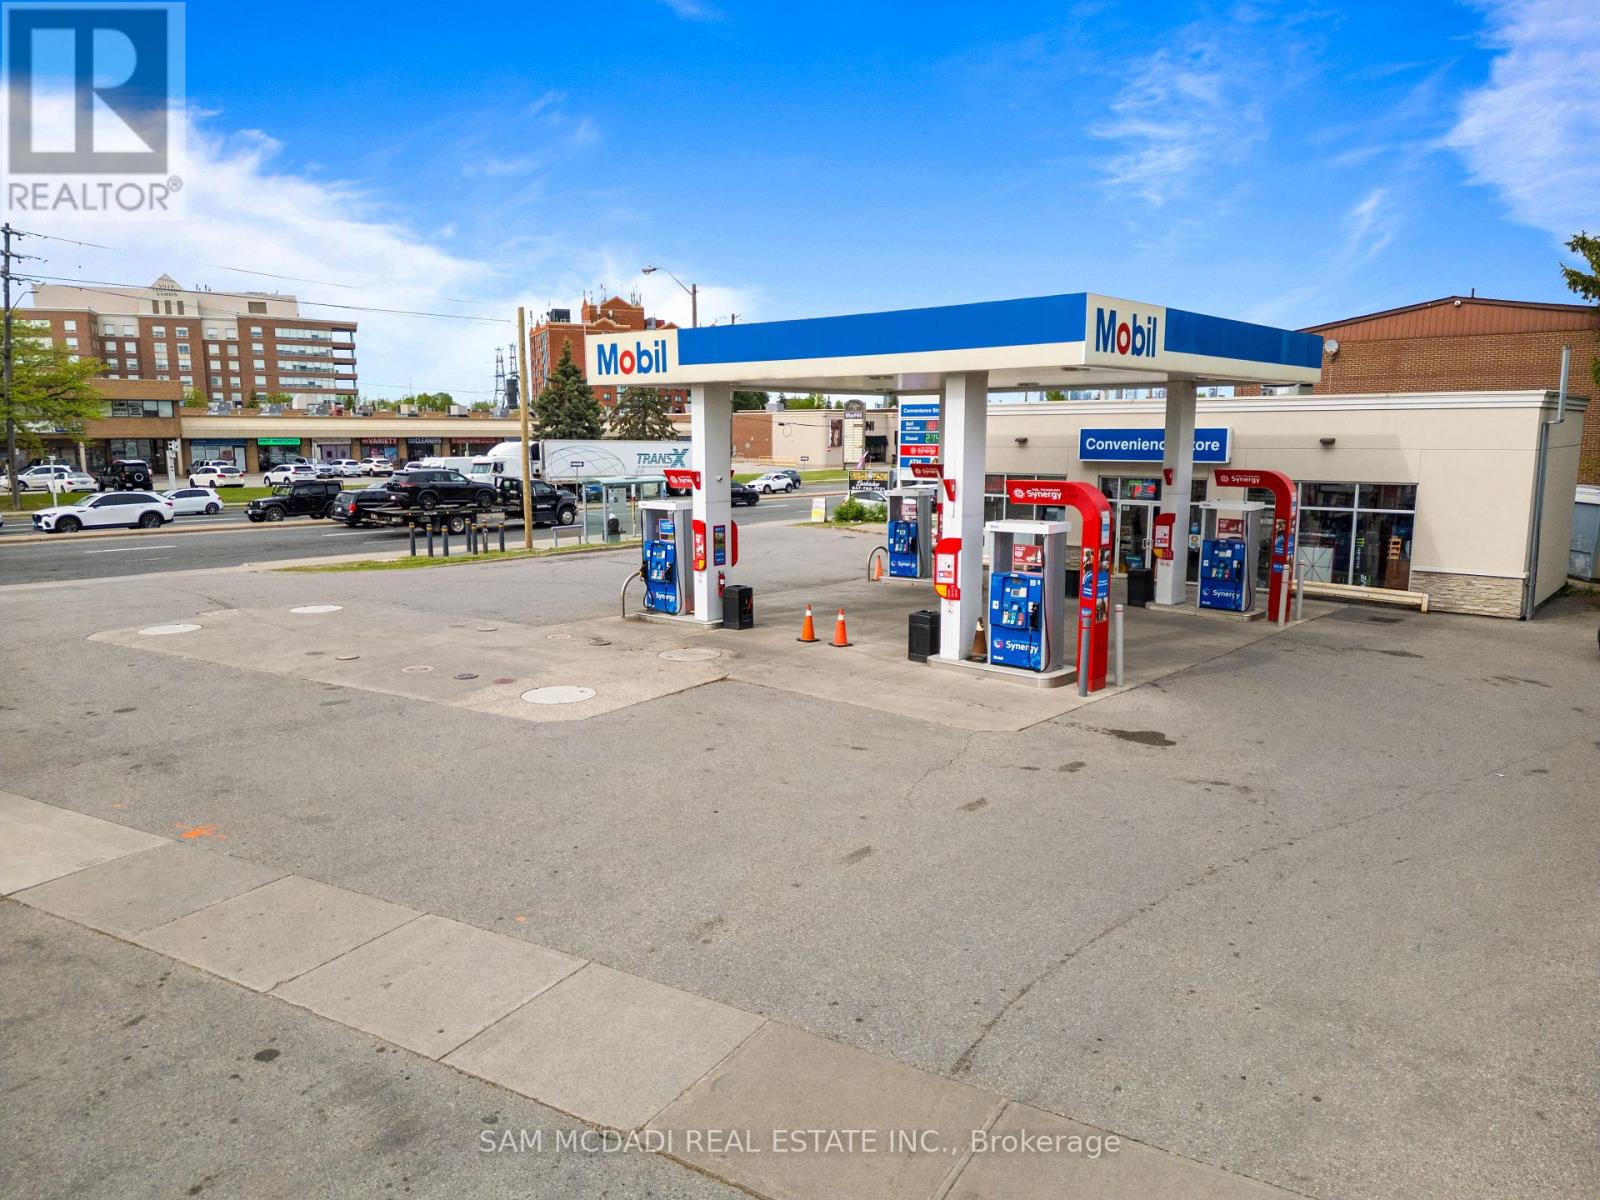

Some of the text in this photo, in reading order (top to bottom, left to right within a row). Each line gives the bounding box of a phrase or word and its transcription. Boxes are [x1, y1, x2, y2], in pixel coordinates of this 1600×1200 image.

[1095, 308, 1157, 358] Mobil
[597, 339, 667, 375] Mobil
[1085, 437, 1165, 450] Convenienc
[1231, 475, 1260, 484] Synergy
[1026, 490, 1062, 500] Synergy
[1005, 640, 1039, 655] Synergy
